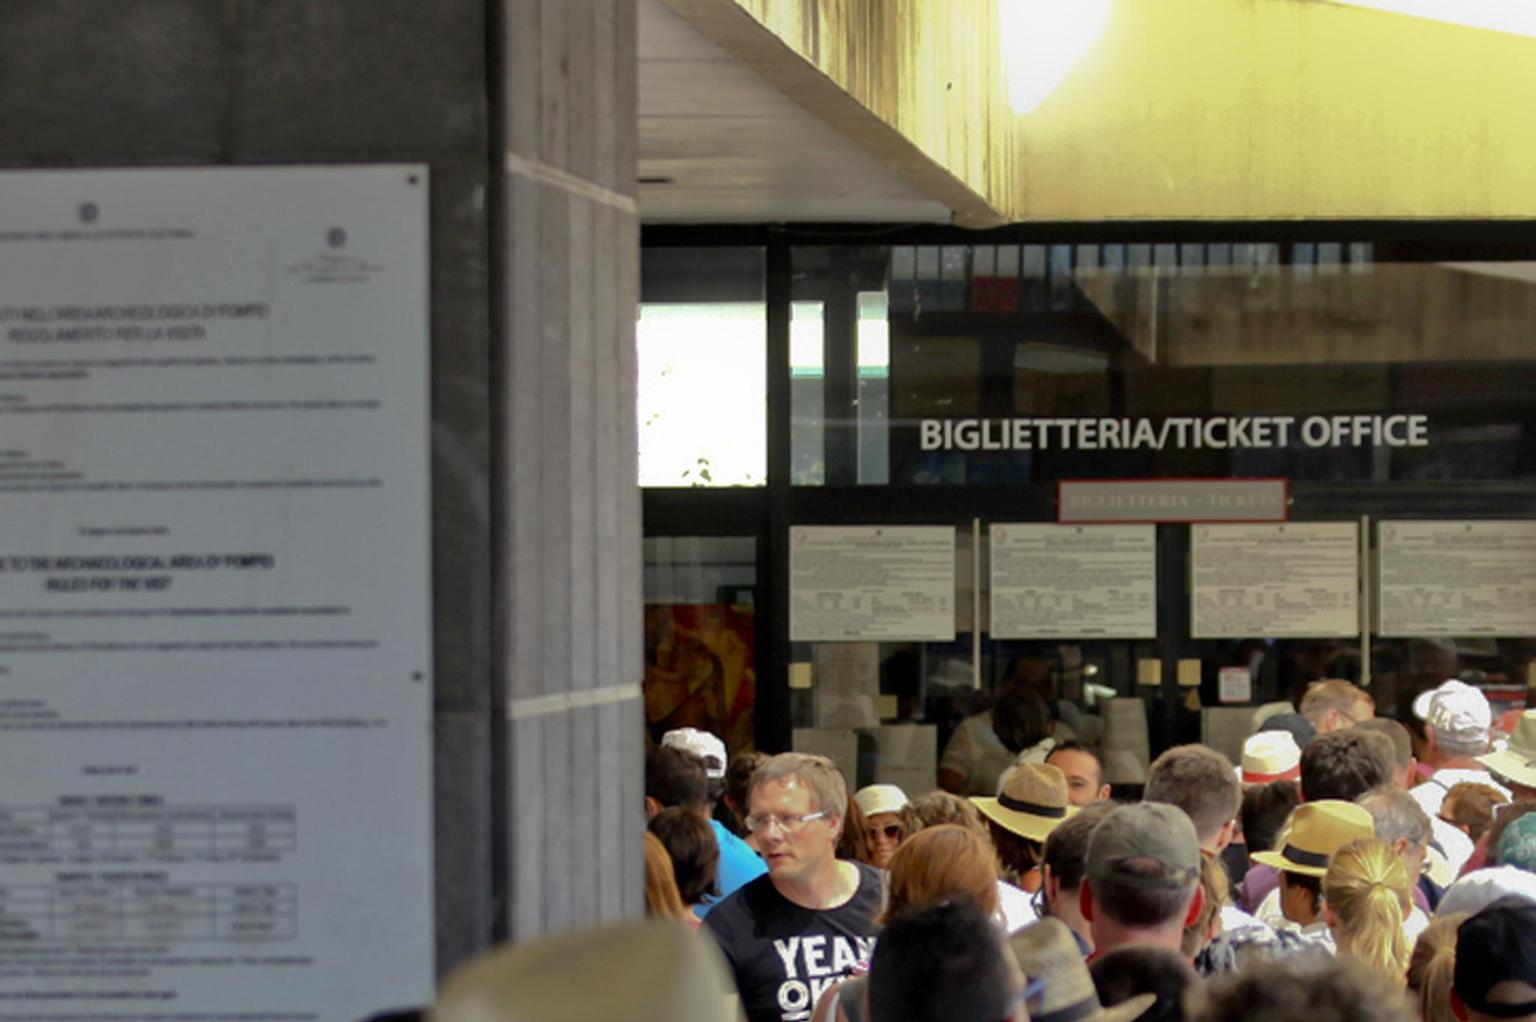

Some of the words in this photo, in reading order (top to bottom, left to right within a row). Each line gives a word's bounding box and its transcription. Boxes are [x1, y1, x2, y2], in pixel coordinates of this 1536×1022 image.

[920, 416, 1295, 451] BIGLIETTERIA/TICKET
[1301, 415, 1429, 448] OFFICE
[1069, 494, 1189, 509] BIGLIETTERIA
